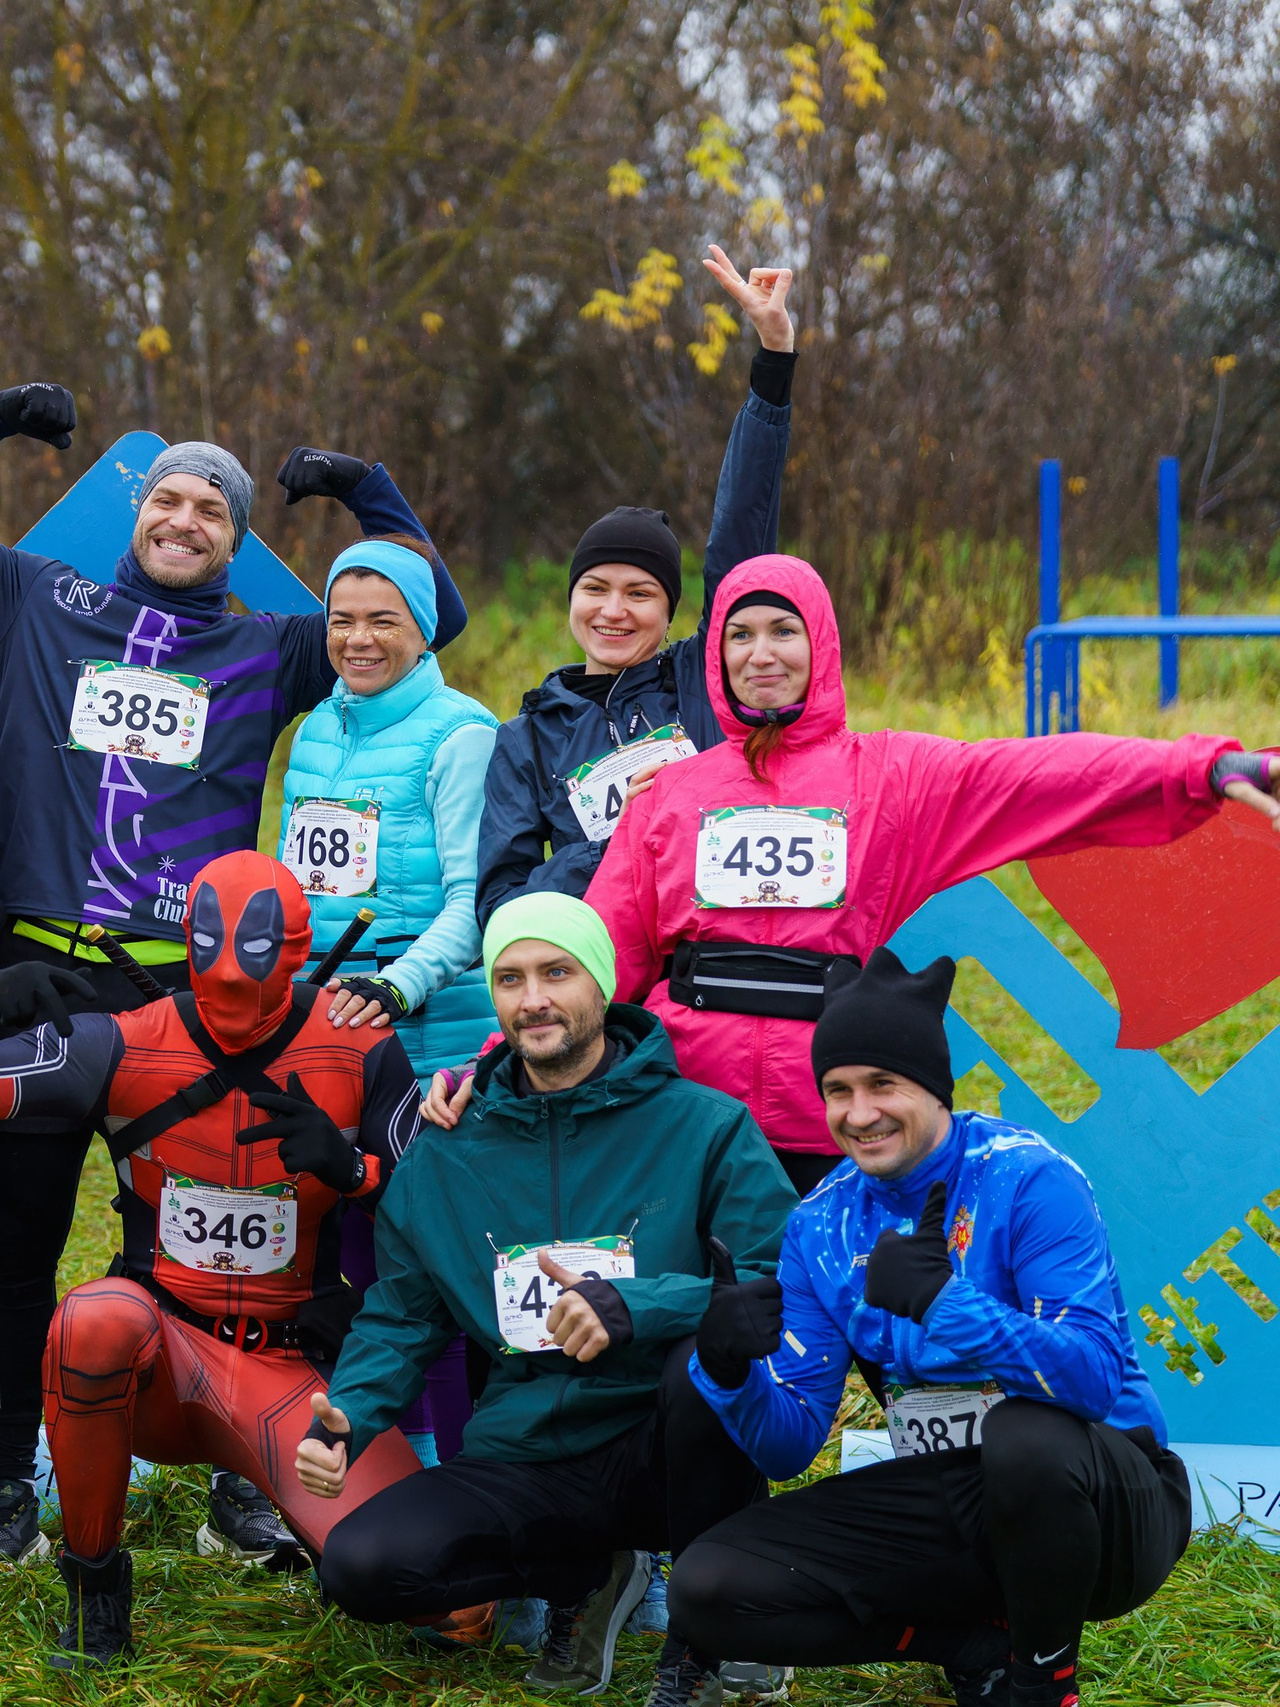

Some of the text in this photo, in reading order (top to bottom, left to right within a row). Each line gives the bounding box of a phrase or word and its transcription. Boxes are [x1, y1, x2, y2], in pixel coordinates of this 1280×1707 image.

[98, 690, 179, 736] 385
[295, 826, 350, 868] 168
[723, 836, 815, 877] 435
[157, 876, 192, 901] Tra
[183, 1207, 267, 1250] 346
[907, 1411, 978, 1456] 387
